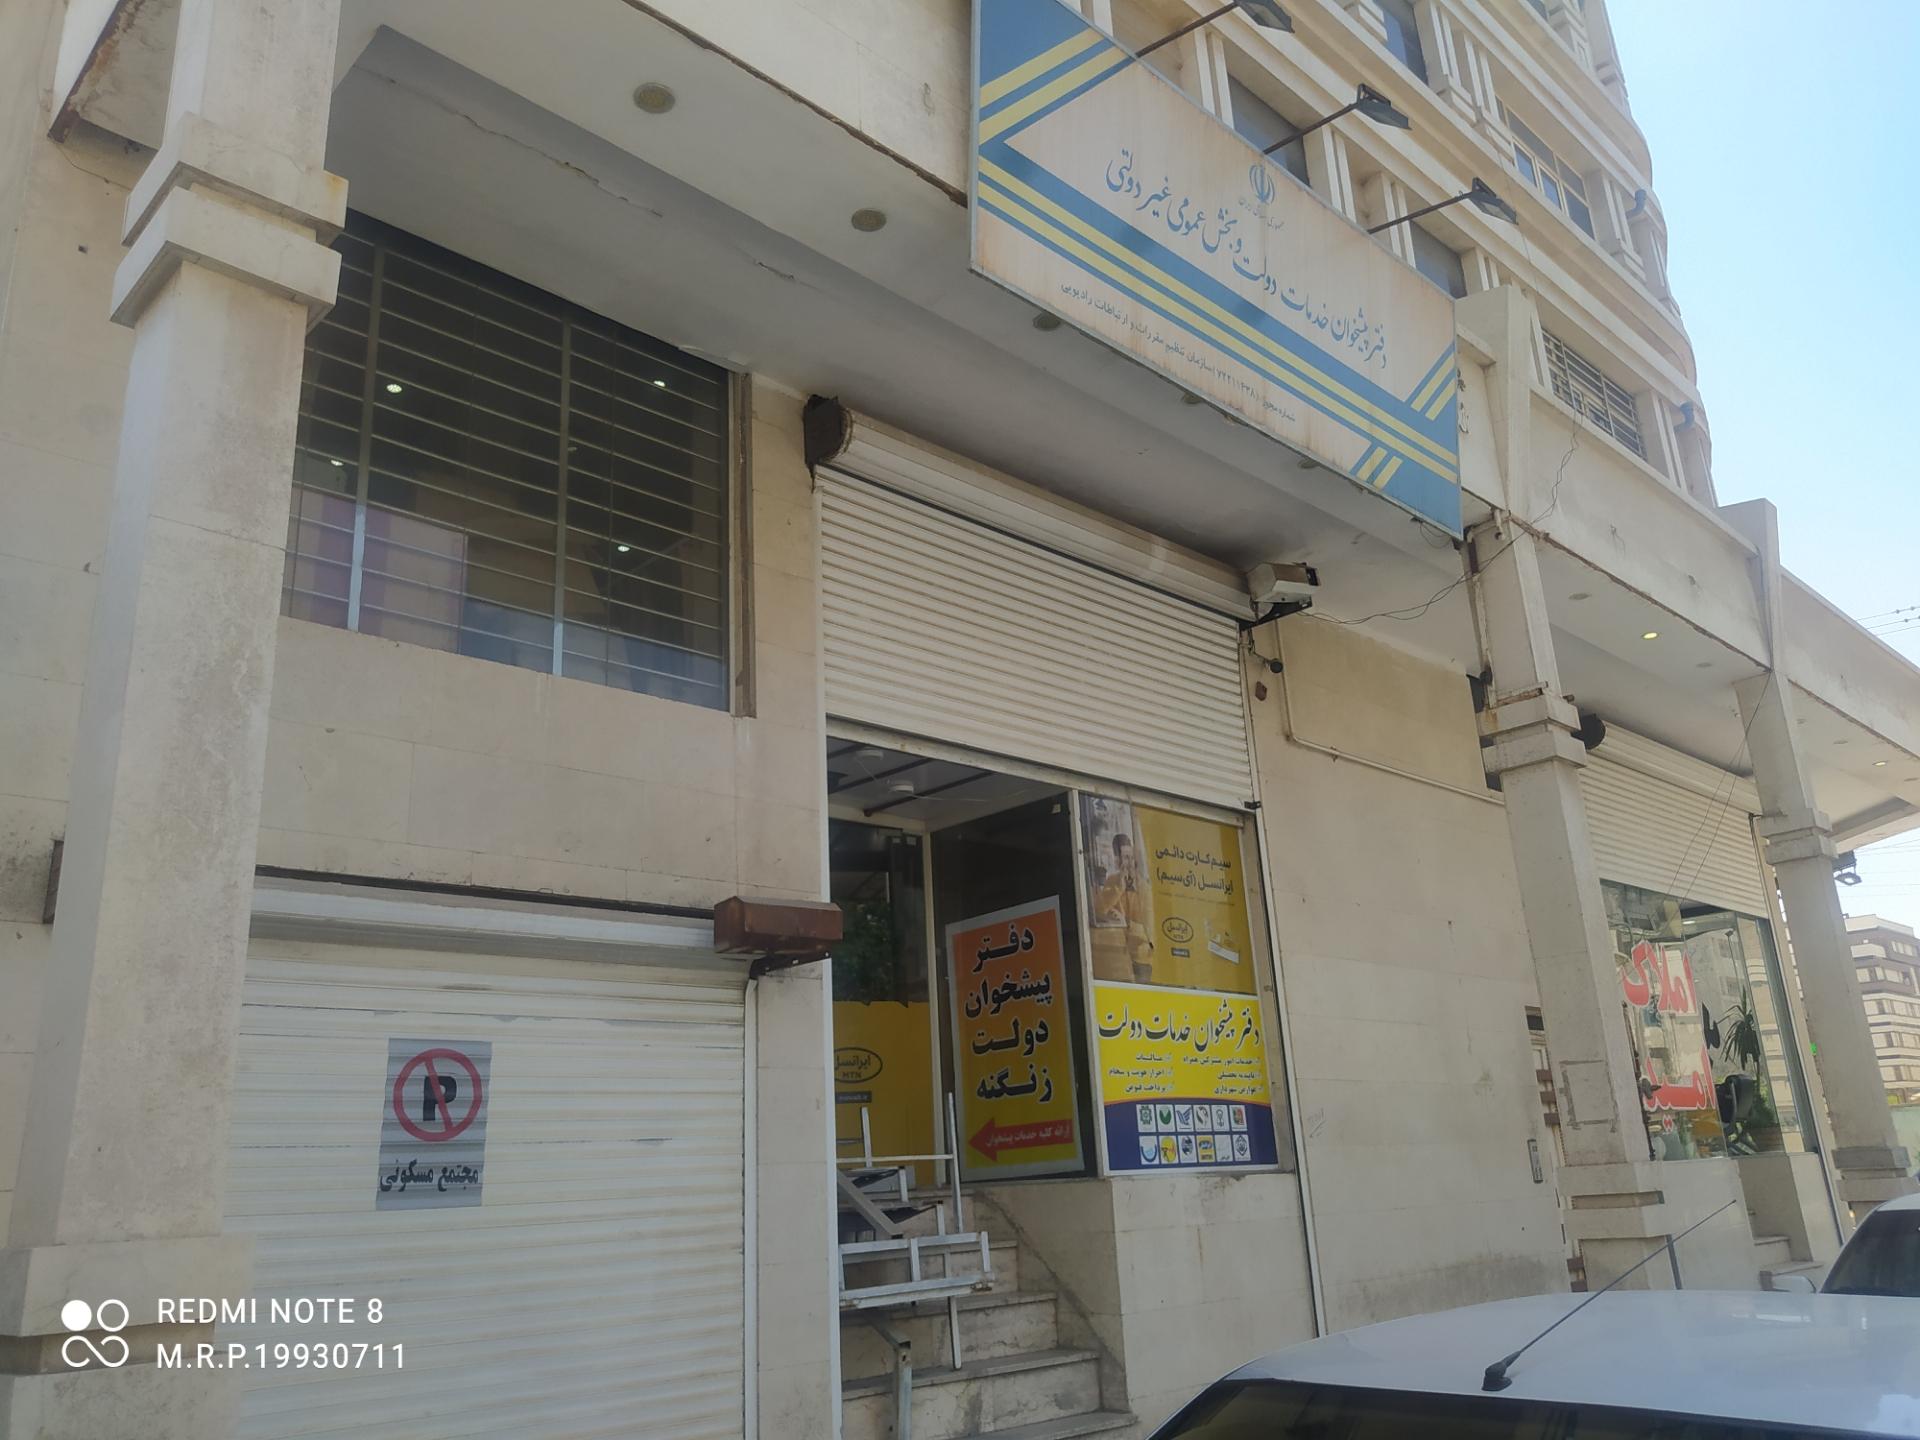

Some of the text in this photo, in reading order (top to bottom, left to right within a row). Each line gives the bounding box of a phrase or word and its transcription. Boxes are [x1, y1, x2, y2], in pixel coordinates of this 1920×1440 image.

[1105, 148, 1142, 199] دولتی
[1135, 176, 1173, 218] غیر
[1166, 198, 1207, 236] عمومی
[1202, 207, 1238, 254] بخش
[1232, 255, 1277, 295] دولت
[1060, 284, 1093, 306] رادیویی
[1094, 300, 1129, 326] ارتباطات
[1281, 287, 1329, 329] خدمات
[1135, 323, 1164, 344] مقررات
[1331, 306, 1369, 353] پیشخوان
[1364, 323, 1387, 369] دفتر
[1164, 343, 1185, 356] تنظیم
[1155, 845, 1185, 860] دائمی
[1185, 850, 1211, 866] کارت
[1197, 873, 1234, 896] ایرانسل
[973, 924, 1034, 972] دفتر
[965, 970, 1053, 1018] پیشخوان
[1621, 940, 1698, 1014] املاک
[972, 1018, 1049, 1056] دولت
[1098, 999, 1260, 1052] دفتر پیشخوان خدمات دولت
[977, 1064, 1053, 1102] زنگنه
[380, 1158, 479, 1192] مجتمع مسکونی
